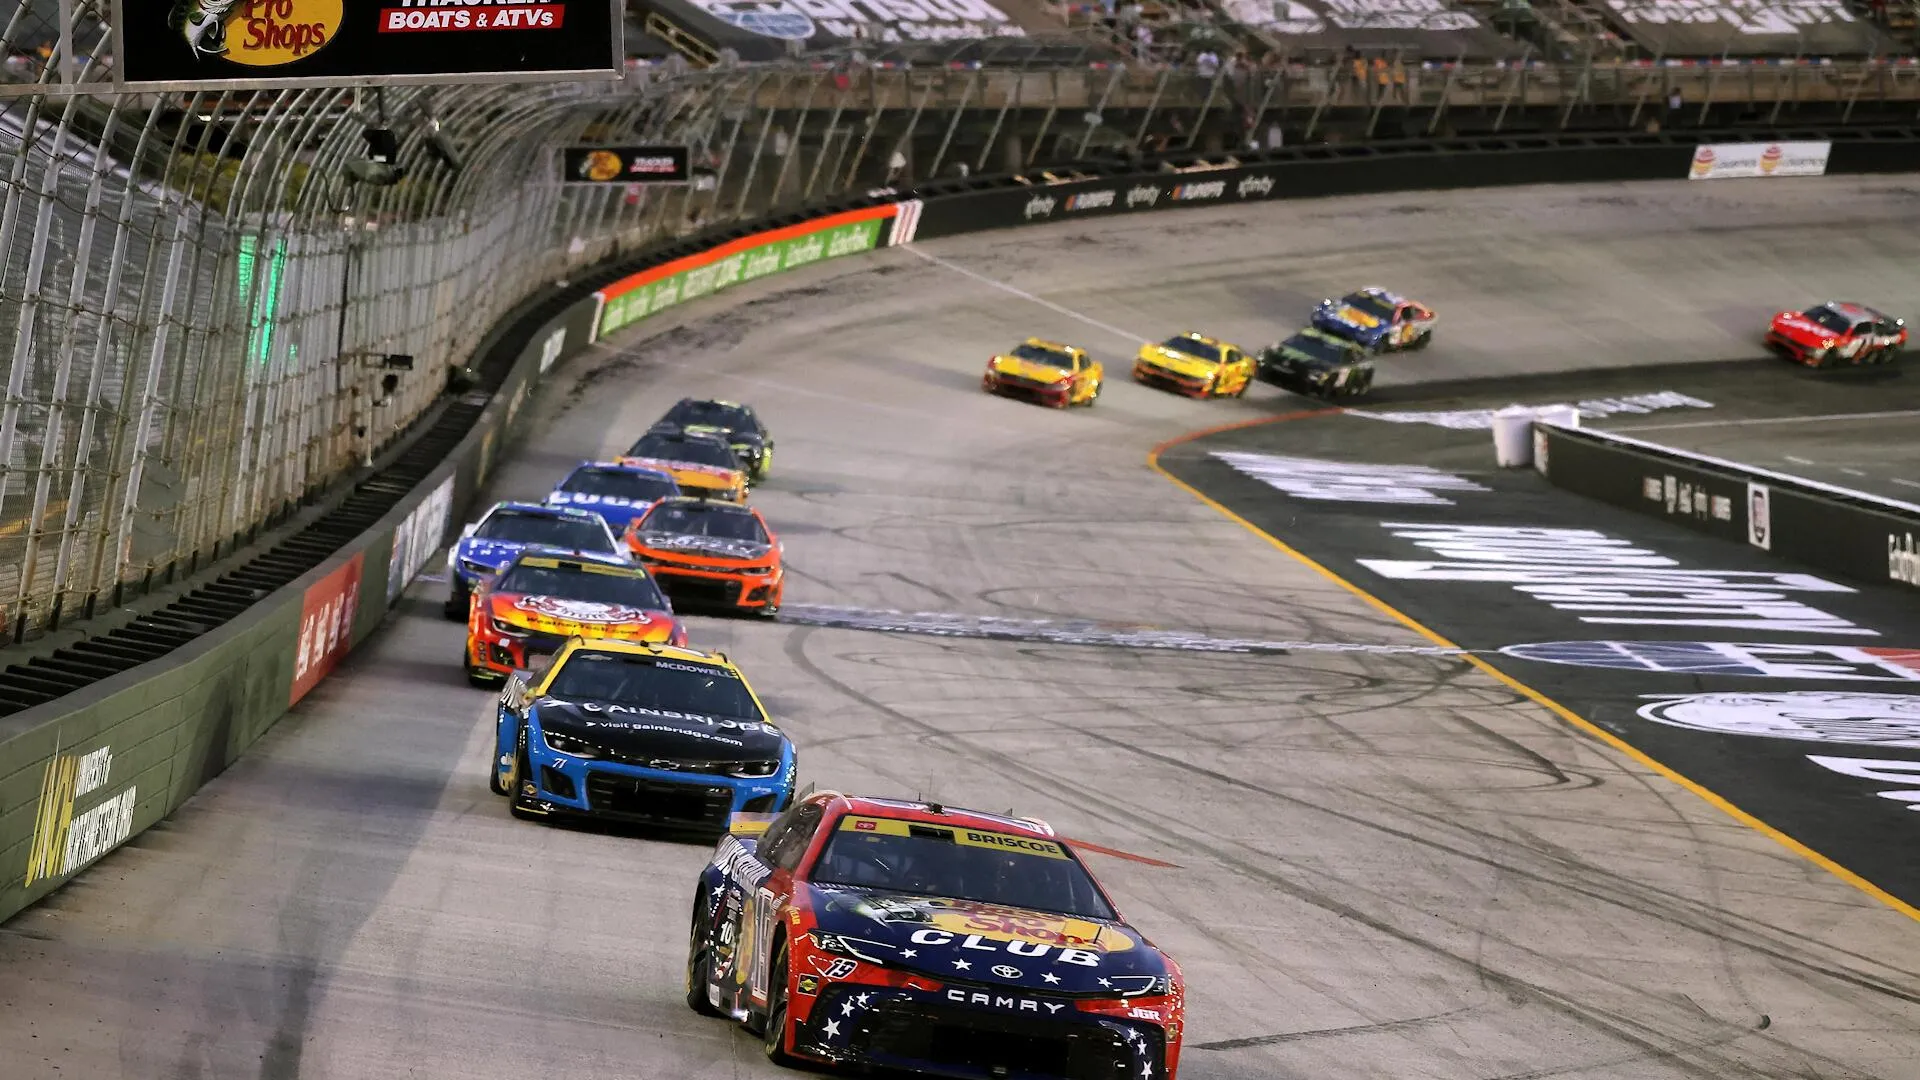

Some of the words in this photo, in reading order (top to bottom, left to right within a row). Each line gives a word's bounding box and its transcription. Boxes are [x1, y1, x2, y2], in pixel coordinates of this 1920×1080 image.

[389, 10, 471, 29] BOATS
[476, 13, 488, 27] &
[492, 9, 554, 27] ATVs
[243, 18, 325, 56] Shops
[655, 661, 733, 678] MCDOWELL
[599, 720, 629, 729] visit
[633, 723, 743, 747] gainbridge.com
[553, 758, 565, 769] 71
[967, 832, 1059, 854] BRISCOE
[720, 921, 734, 945] 10
[910, 929, 1101, 968] CLUB
[824, 958, 858, 979] 19
[947, 989, 1066, 1015] CAMRY
[1127, 1007, 1161, 1021] JGR
